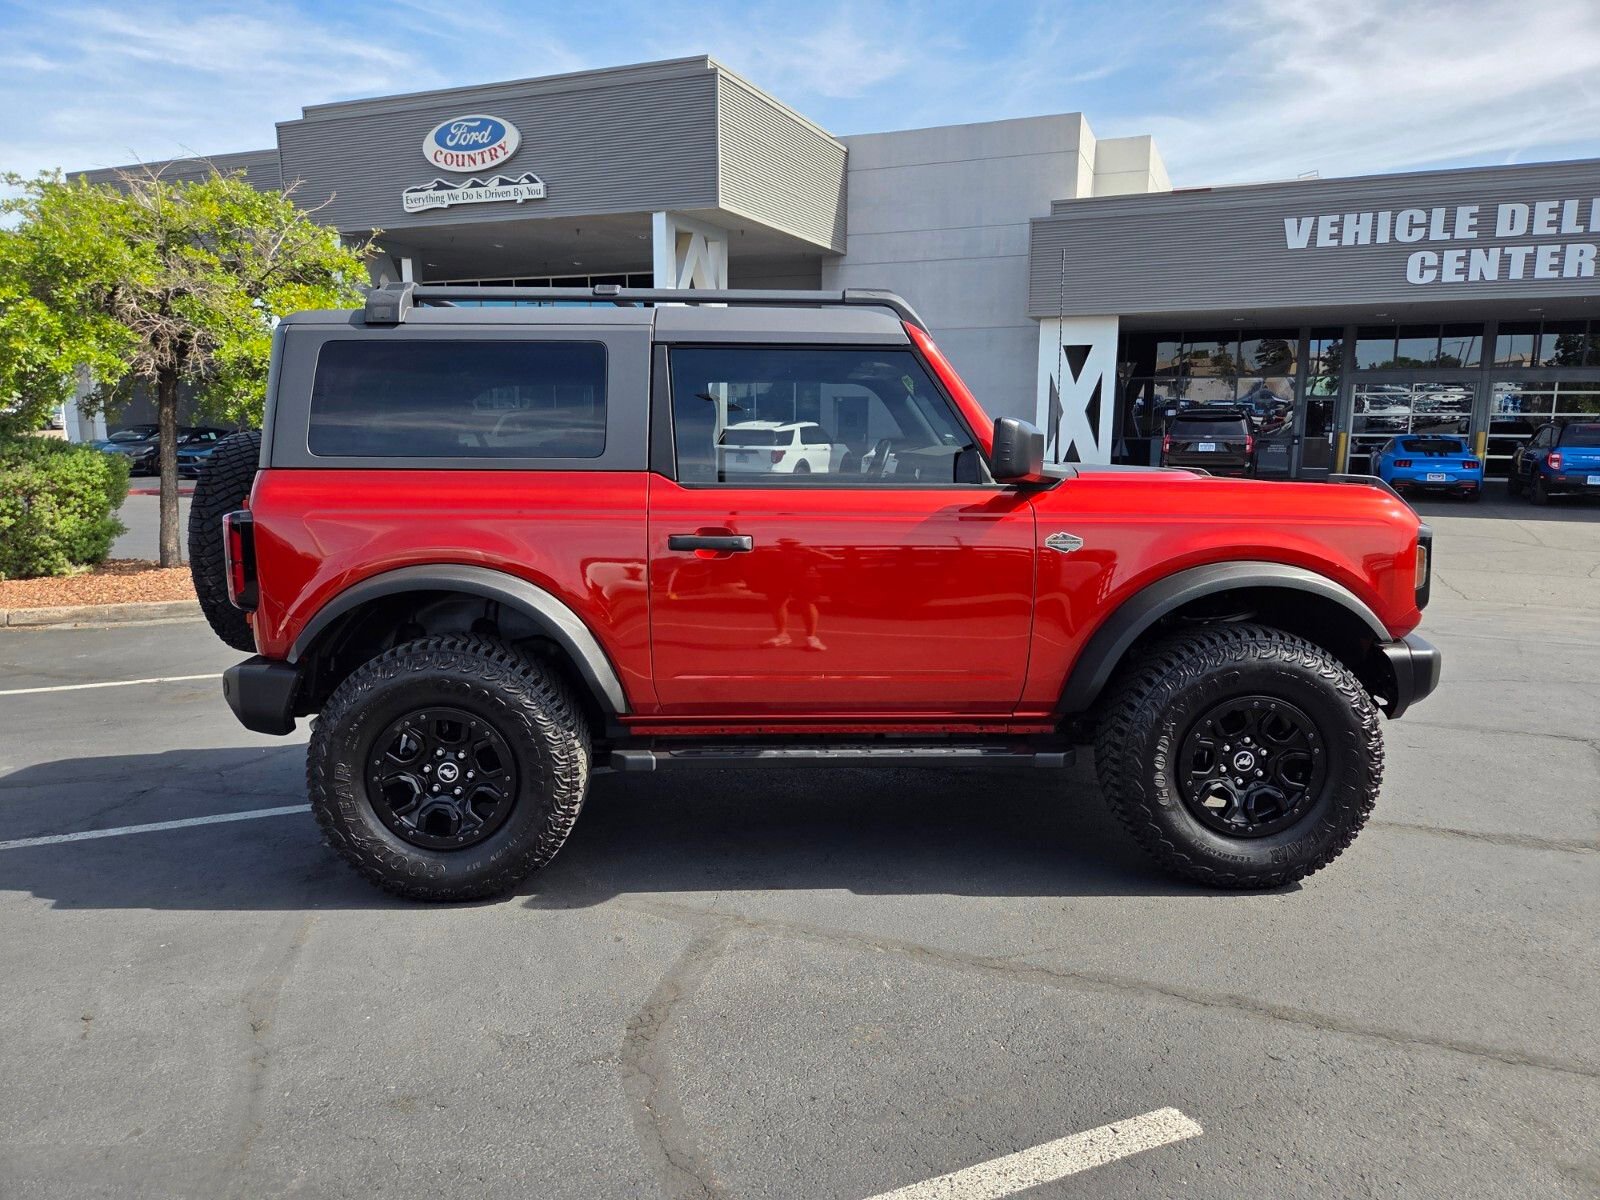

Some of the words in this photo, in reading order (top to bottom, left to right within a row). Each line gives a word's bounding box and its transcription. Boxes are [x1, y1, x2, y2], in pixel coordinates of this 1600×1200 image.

[446, 121, 493, 146] Ford
[433, 141, 509, 167] COUNTRY
[405, 193, 445, 205] Everything
[447, 193, 460, 202] We
[462, 191, 474, 201] Do
[476, 190, 482, 199] Is
[484, 188, 511, 199] Driven
[513, 187, 523, 199] By
[527, 186, 541, 196] You
[1284, 205, 1479, 249] VEHICLE
[1406, 243, 1598, 285] CENTER
